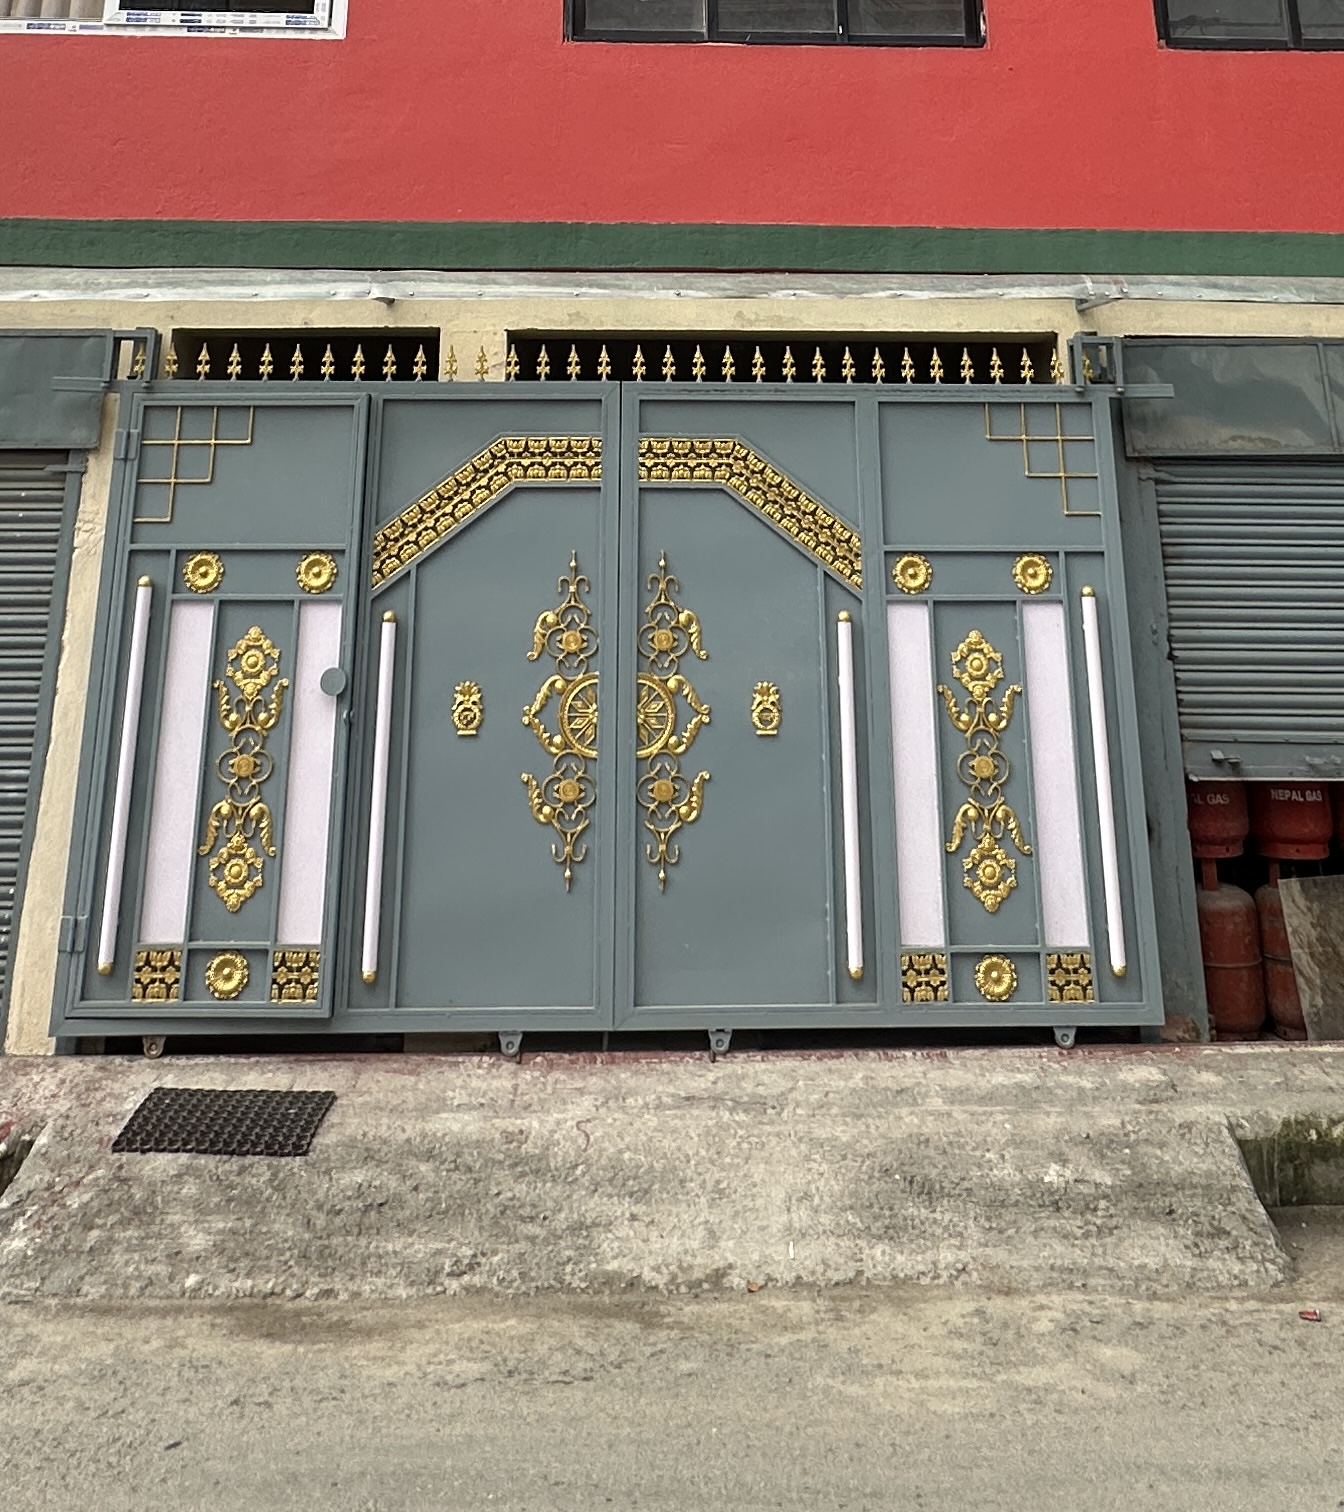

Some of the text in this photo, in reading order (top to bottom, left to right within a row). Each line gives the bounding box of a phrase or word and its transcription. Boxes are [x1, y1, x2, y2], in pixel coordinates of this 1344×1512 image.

[1206, 793, 1229, 805] GAS
[1270, 788, 1323, 802] NEPAL GAS
